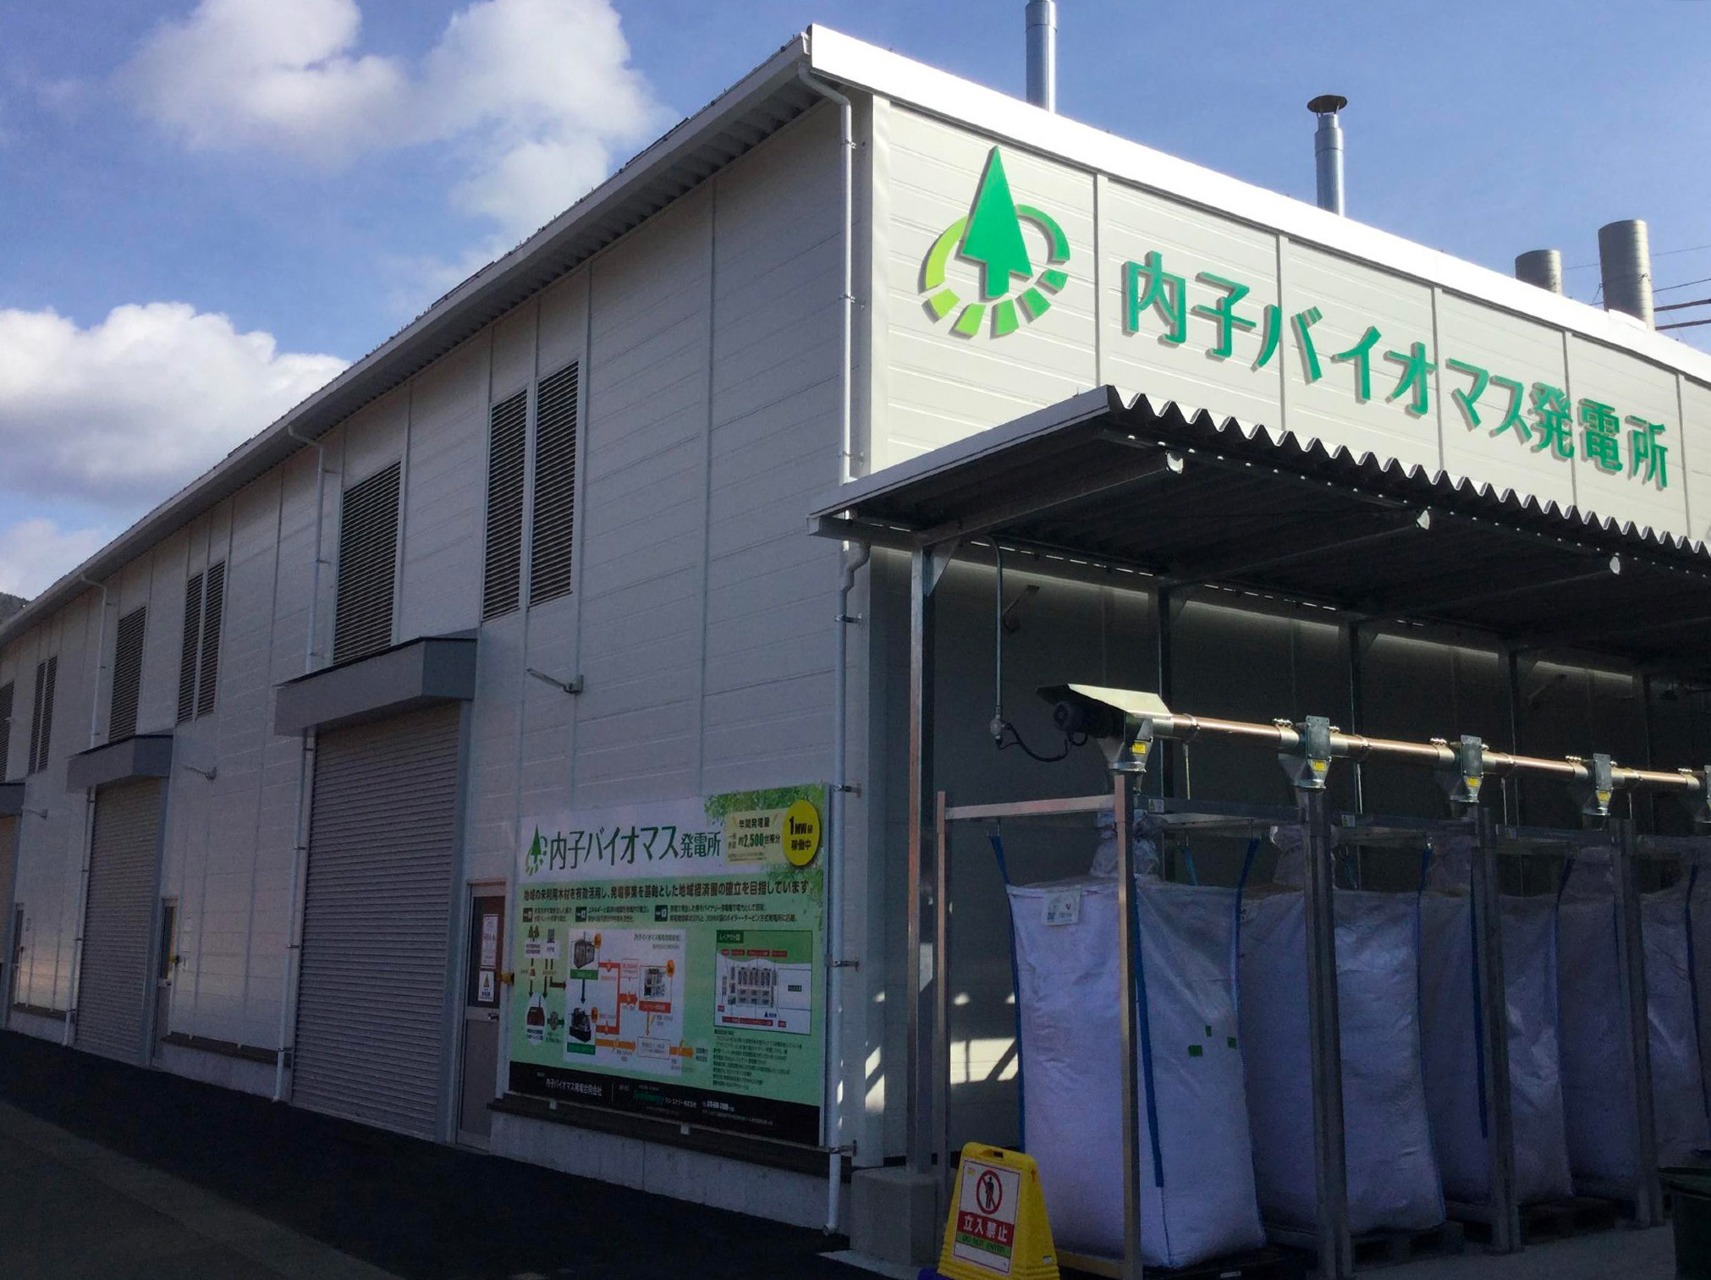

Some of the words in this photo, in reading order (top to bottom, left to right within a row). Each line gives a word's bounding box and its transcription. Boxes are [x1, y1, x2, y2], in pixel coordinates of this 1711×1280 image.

[1121, 251, 1669, 490] 内子バイオマス発電所
[549, 825, 721, 871] 内子バイオマス発電所
[963, 1215, 1008, 1242] 立入禁止
